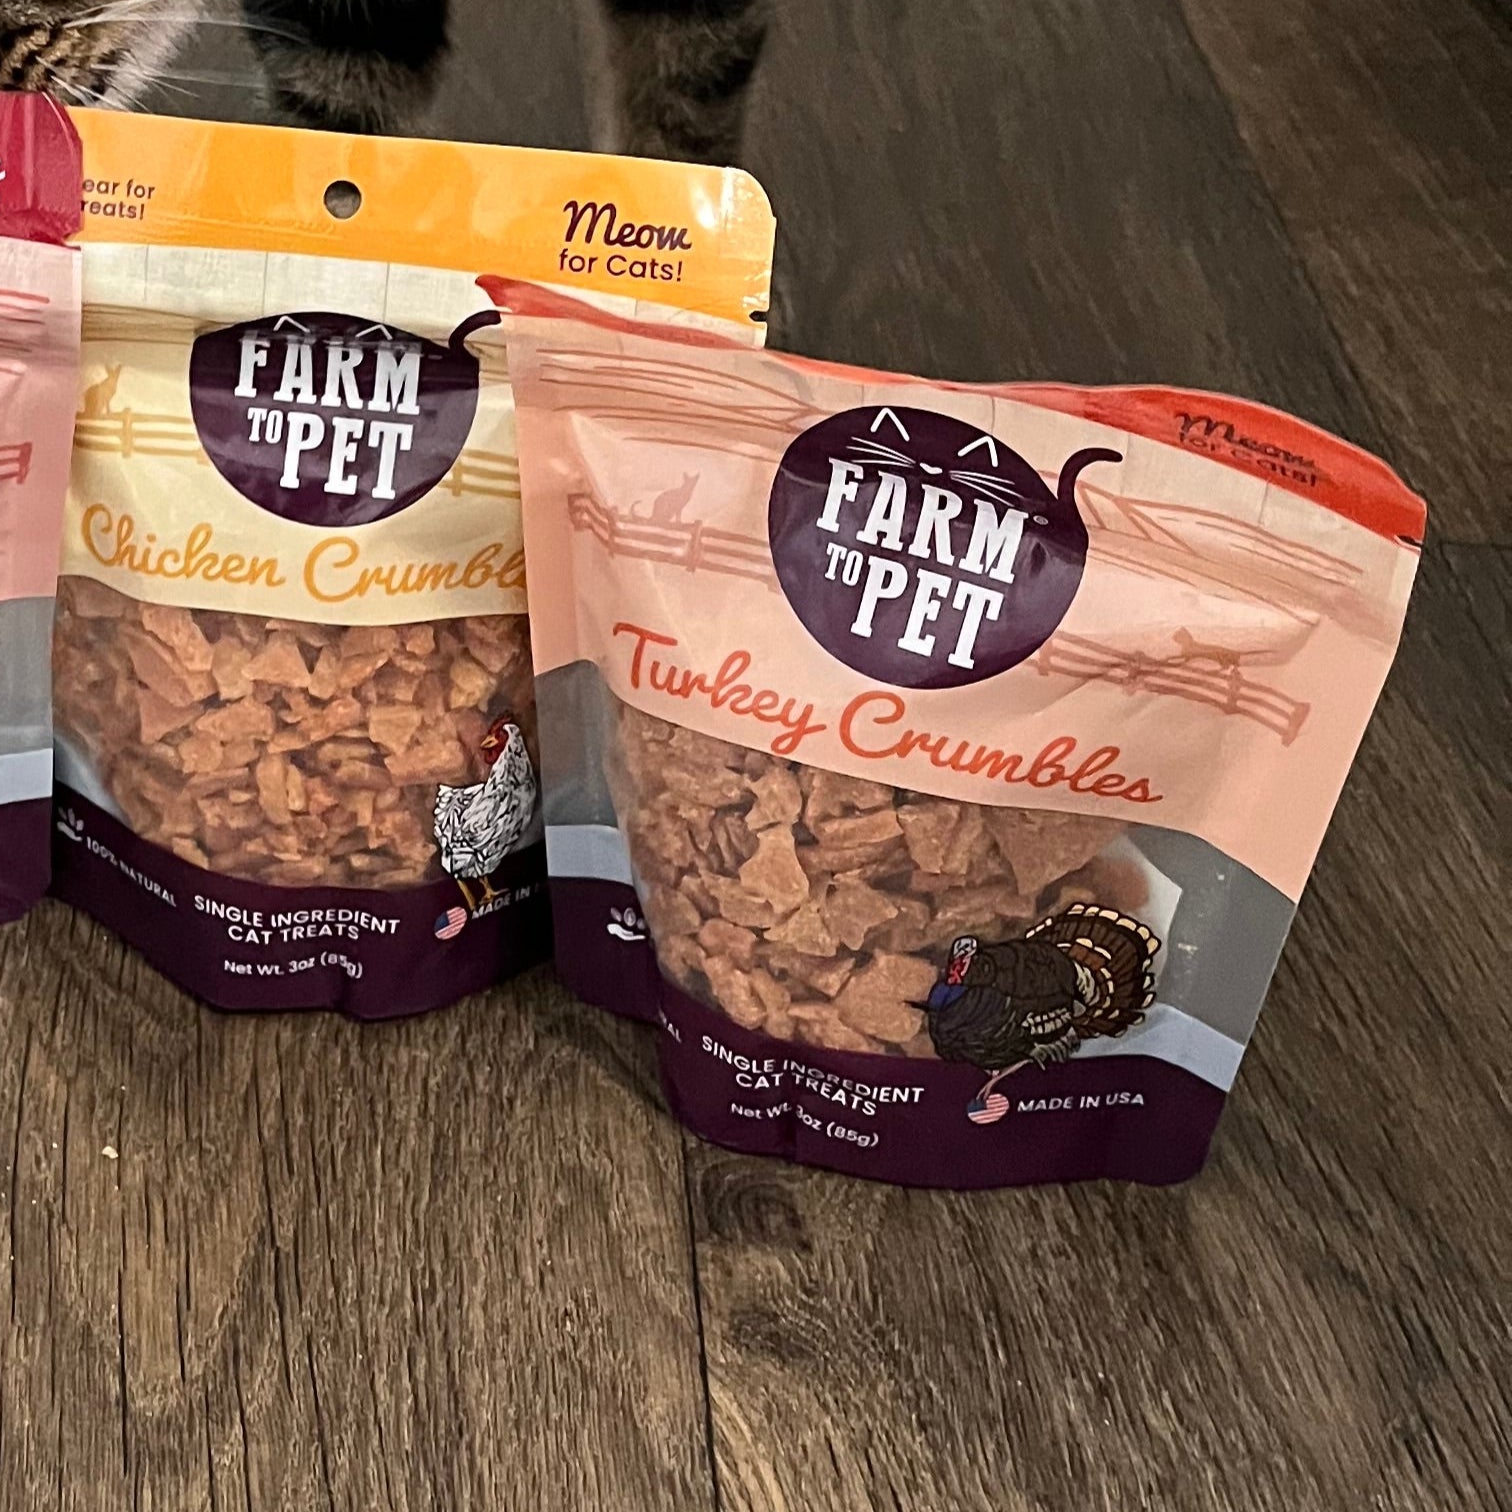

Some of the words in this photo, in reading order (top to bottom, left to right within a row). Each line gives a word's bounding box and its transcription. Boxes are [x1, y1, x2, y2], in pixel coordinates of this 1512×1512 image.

[80, 199, 145, 220] reats!
[82, 179, 120, 195] ear
[126, 178, 155, 199] for
[563, 200, 692, 251] Meow
[559, 248, 598, 274] for
[606, 254, 683, 282] Cats!
[234, 329, 422, 416] FARM
[247, 407, 284, 444] TO
[279, 411, 414, 500] PET
[816, 457, 1029, 584] FARM
[81, 503, 285, 588] Chicken
[303, 535, 526, 603] Crumbl
[824, 542, 864, 587] TO
[850, 555, 1005, 670] PET
[613, 621, 827, 755] Turkey
[839, 689, 1163, 804] Crumbles
[194, 894, 264, 928] SINGLE
[271, 908, 401, 935] INGREDIENT
[227, 925, 273, 945] CAT
[279, 922, 360, 943] TREATS
[224, 959, 253, 975] Net
[288, 956, 315, 974] 3oz
[701, 1035, 776, 1074] SINGLE
[782, 1059, 925, 1103] INGREDIENT
[735, 1072, 783, 1089] CAT
[791, 1072, 877, 1117] TREATS
[1017, 1096, 1075, 1113] MADE
[1079, 1095, 1101, 1109] IN
[1105, 1091, 1145, 1106] USA
[730, 1102, 763, 1120] Net
[826, 1121, 880, 1148] (85g)
